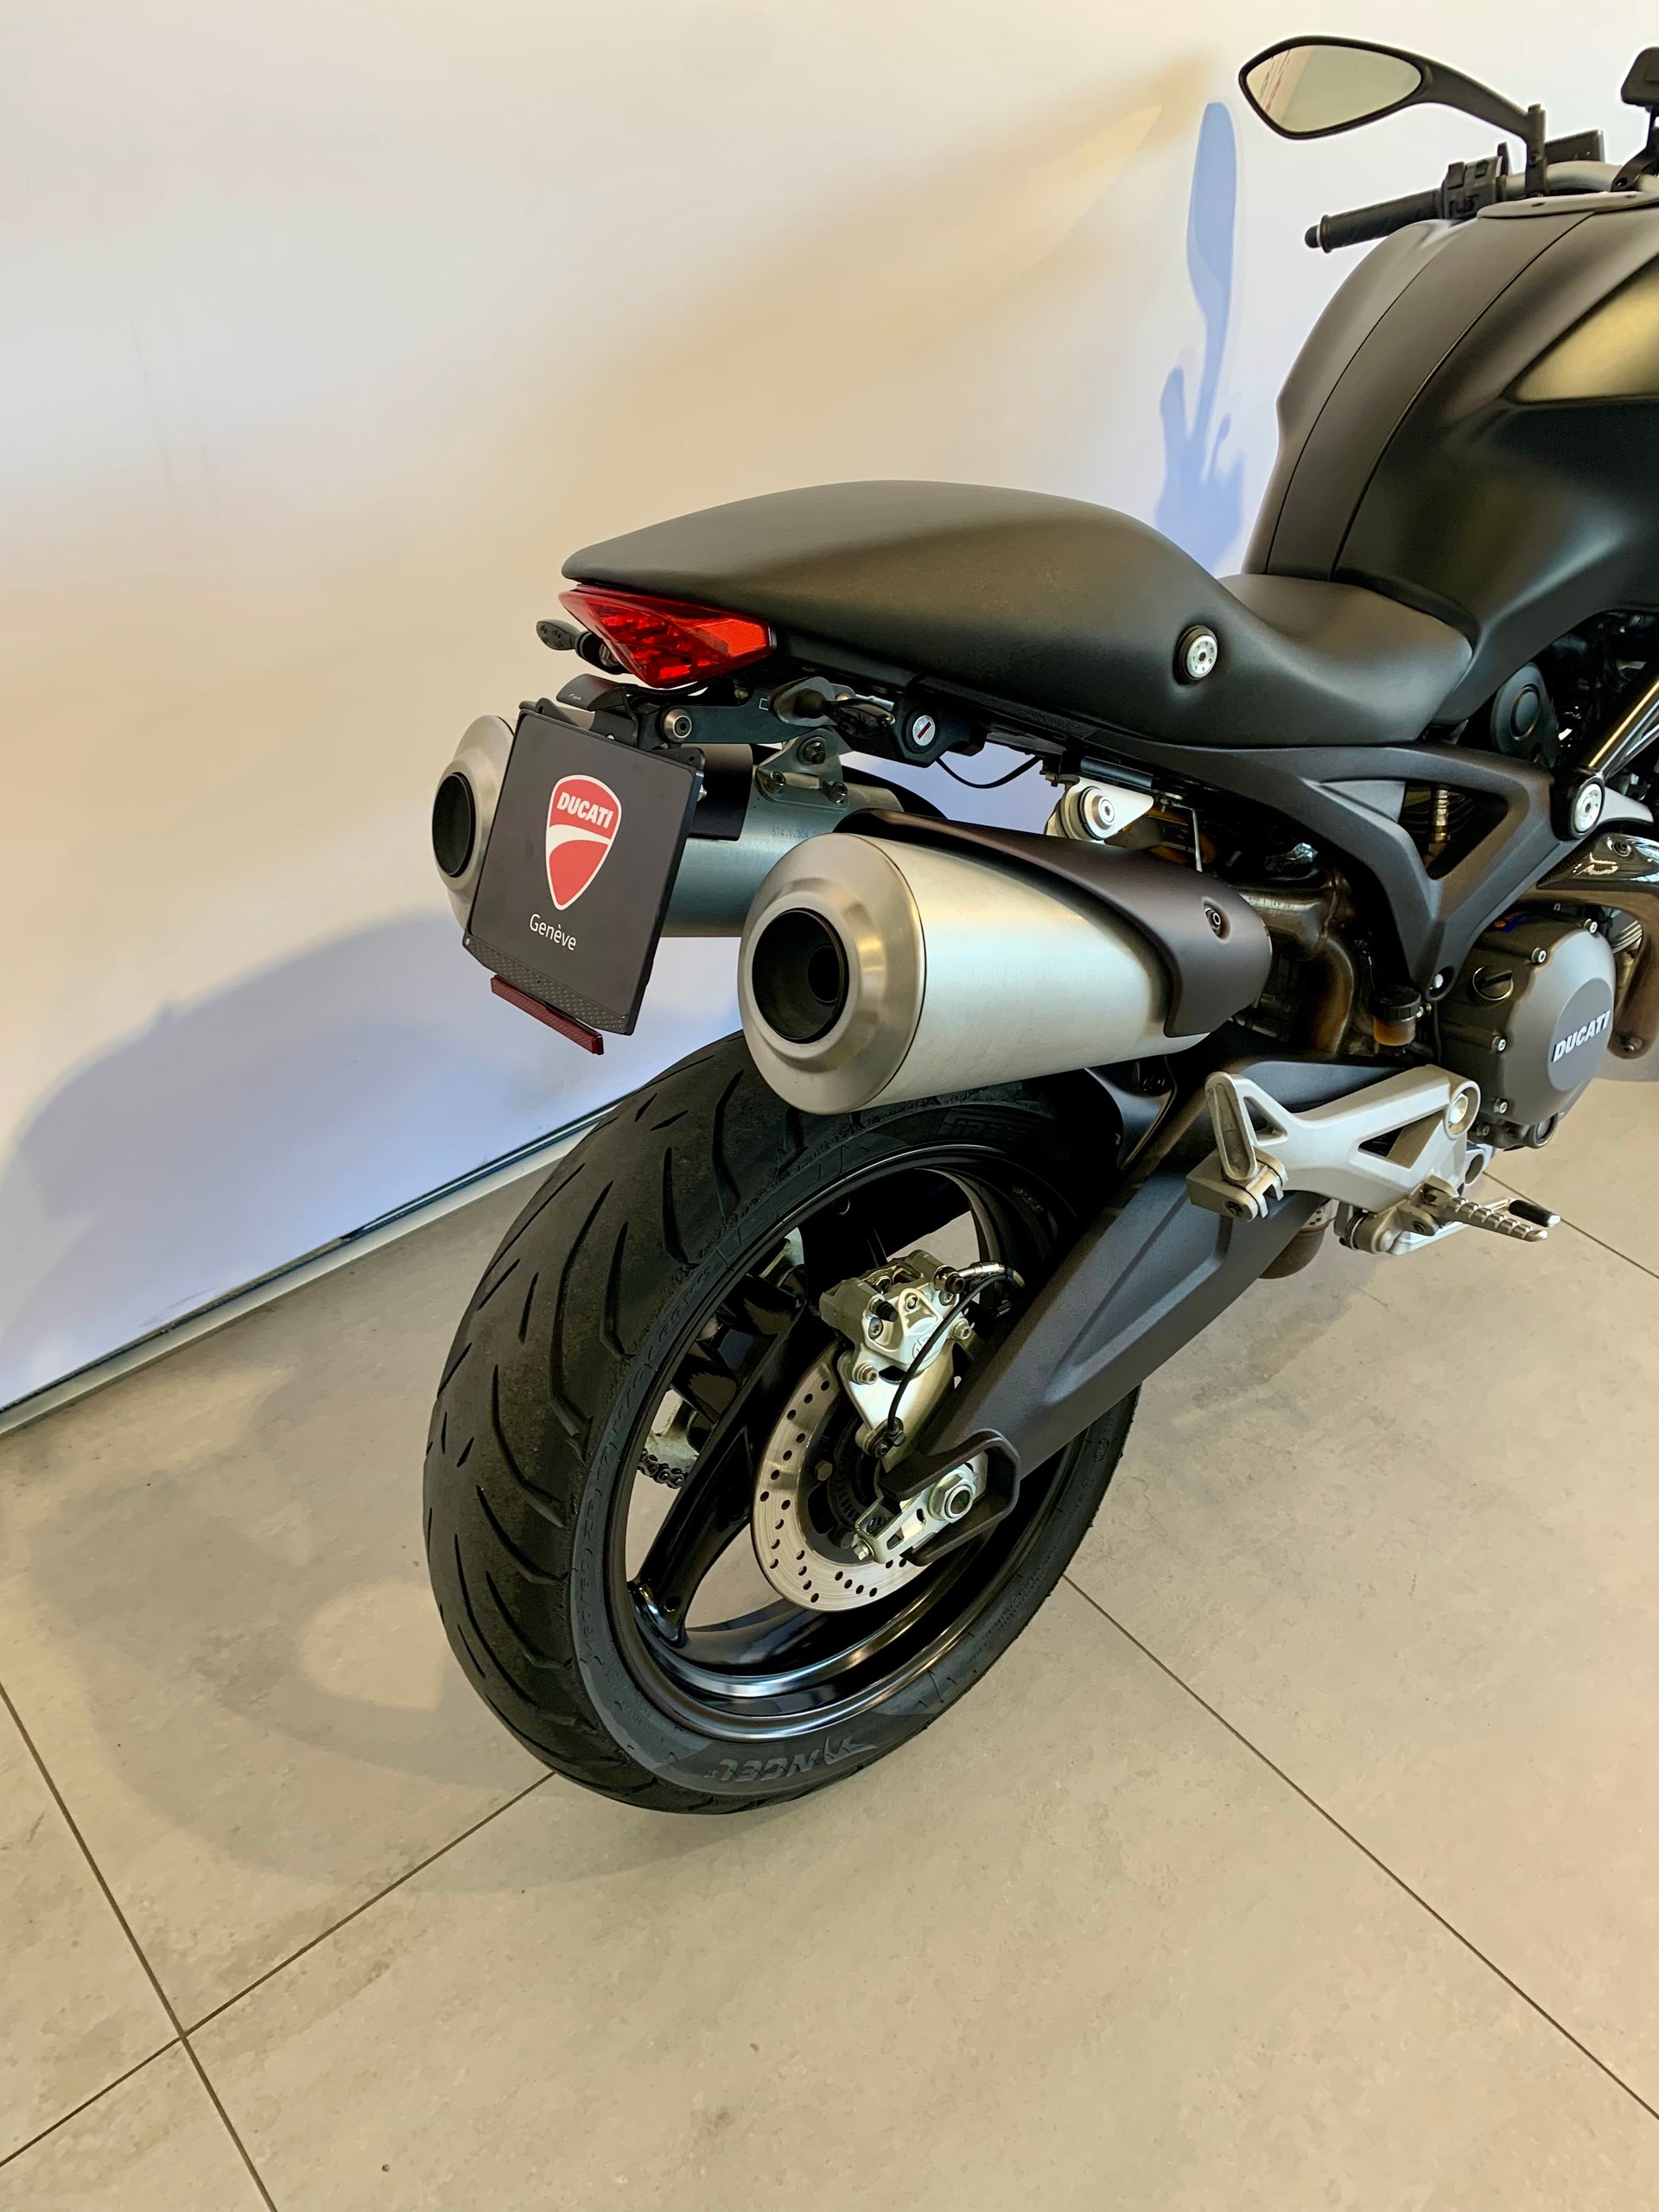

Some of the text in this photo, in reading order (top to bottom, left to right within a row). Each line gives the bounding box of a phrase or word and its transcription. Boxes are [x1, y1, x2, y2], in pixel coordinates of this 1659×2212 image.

[556, 791, 613, 829] DUCATI
[771, 826, 821, 839] 574.1.304
[529, 913, 576, 950] Genève
[1552, 1009, 1611, 1063] DUCATI
